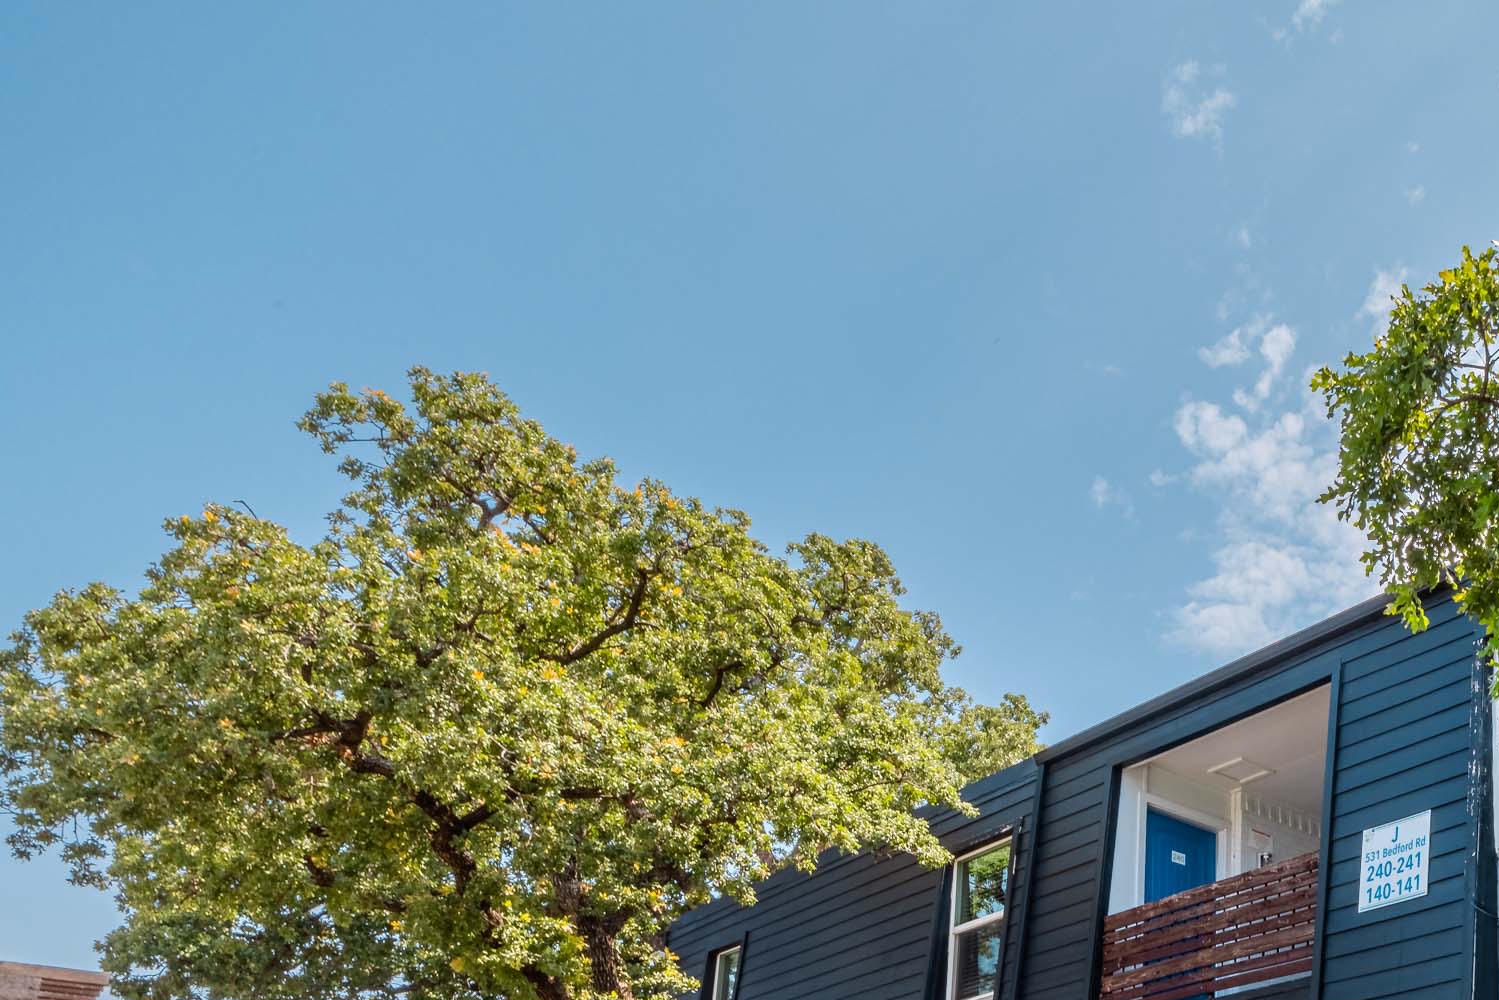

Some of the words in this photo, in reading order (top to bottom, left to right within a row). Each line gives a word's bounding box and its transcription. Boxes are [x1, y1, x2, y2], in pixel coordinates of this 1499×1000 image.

[1391, 826, 1399, 843] J
[1365, 850, 1380, 863] 531
[1383, 841, 1413, 858] Bedford
[1415, 835, 1426, 847] Rd
[1366, 851, 1421, 882] 240-241
[1366, 874, 1420, 903] 140-141
